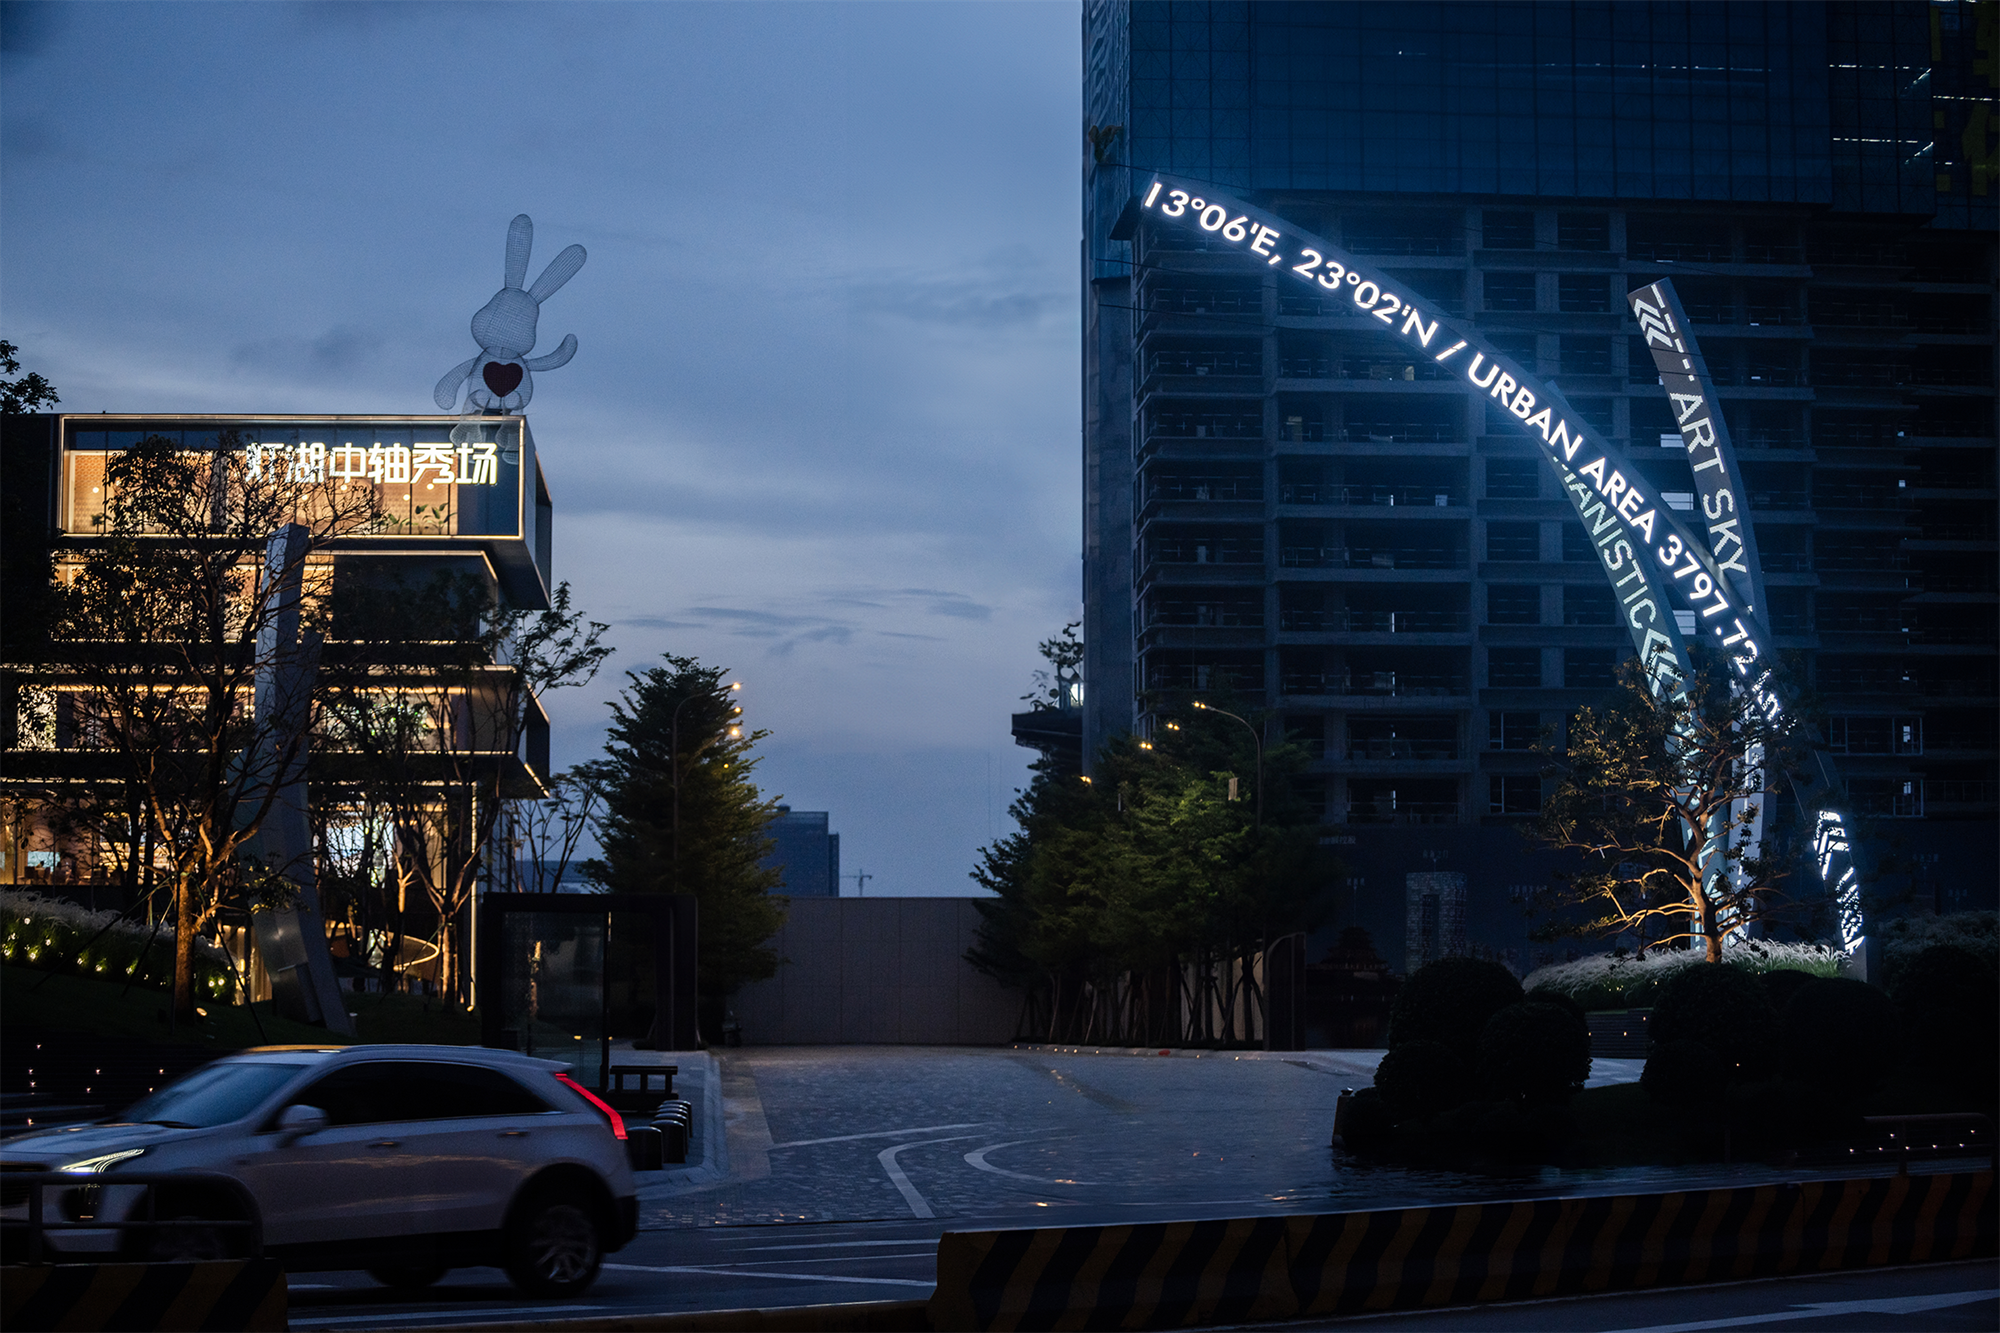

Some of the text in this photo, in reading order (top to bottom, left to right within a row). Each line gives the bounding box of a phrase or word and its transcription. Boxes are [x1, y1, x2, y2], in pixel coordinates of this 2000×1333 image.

[1467, 352, 1584, 462] URBAN
[1579, 456, 1657, 543] AREA
[1669, 392, 1748, 573] ART SKY
